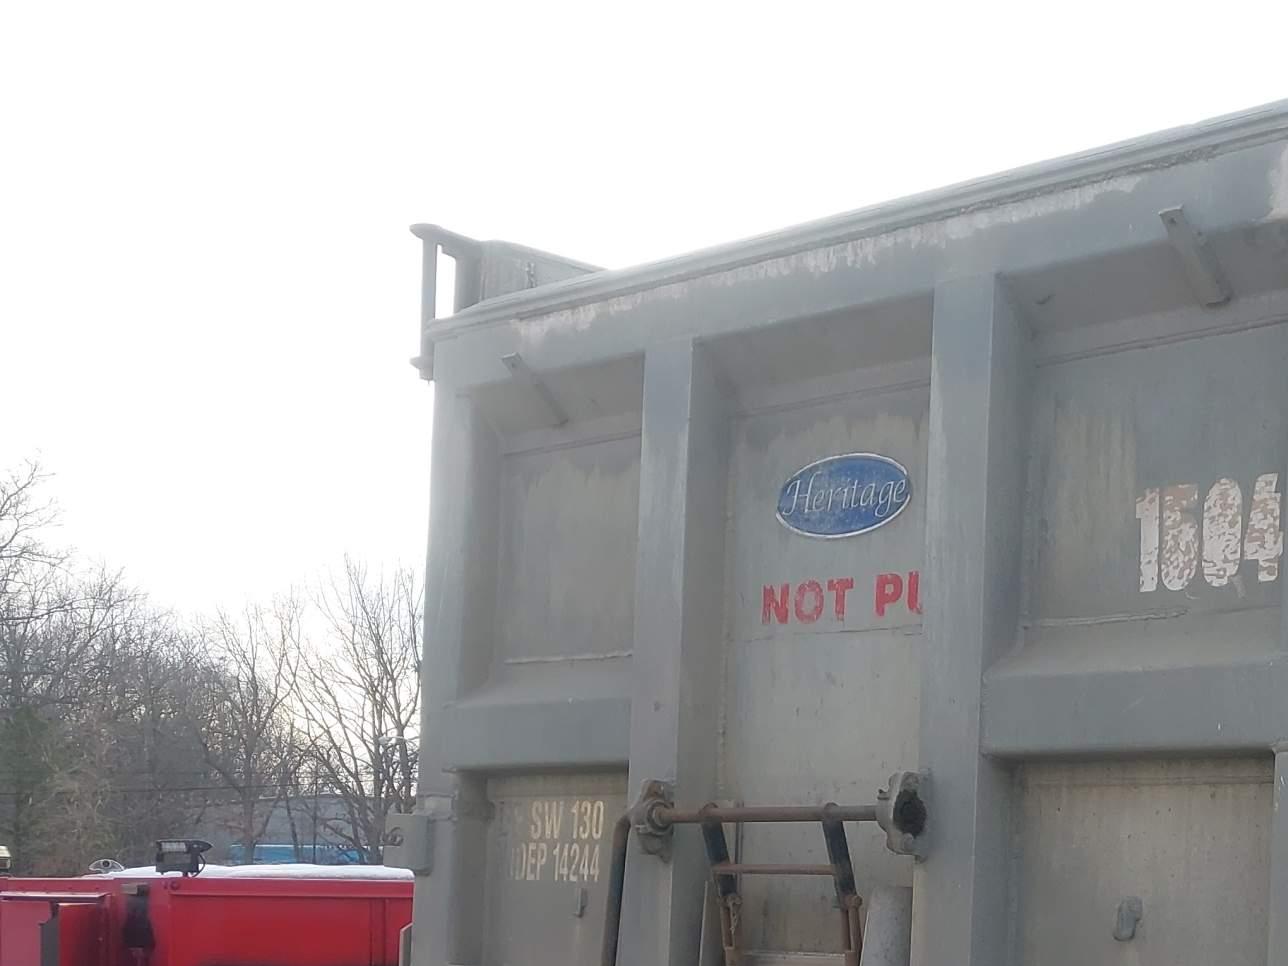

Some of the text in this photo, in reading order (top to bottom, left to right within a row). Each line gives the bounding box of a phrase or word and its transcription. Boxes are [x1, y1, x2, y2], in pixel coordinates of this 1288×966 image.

[781, 471, 908, 518] Heritage
[761, 578, 854, 625] NOT
[531, 800, 604, 840] SW 130
[553, 843, 600, 882] 14244
